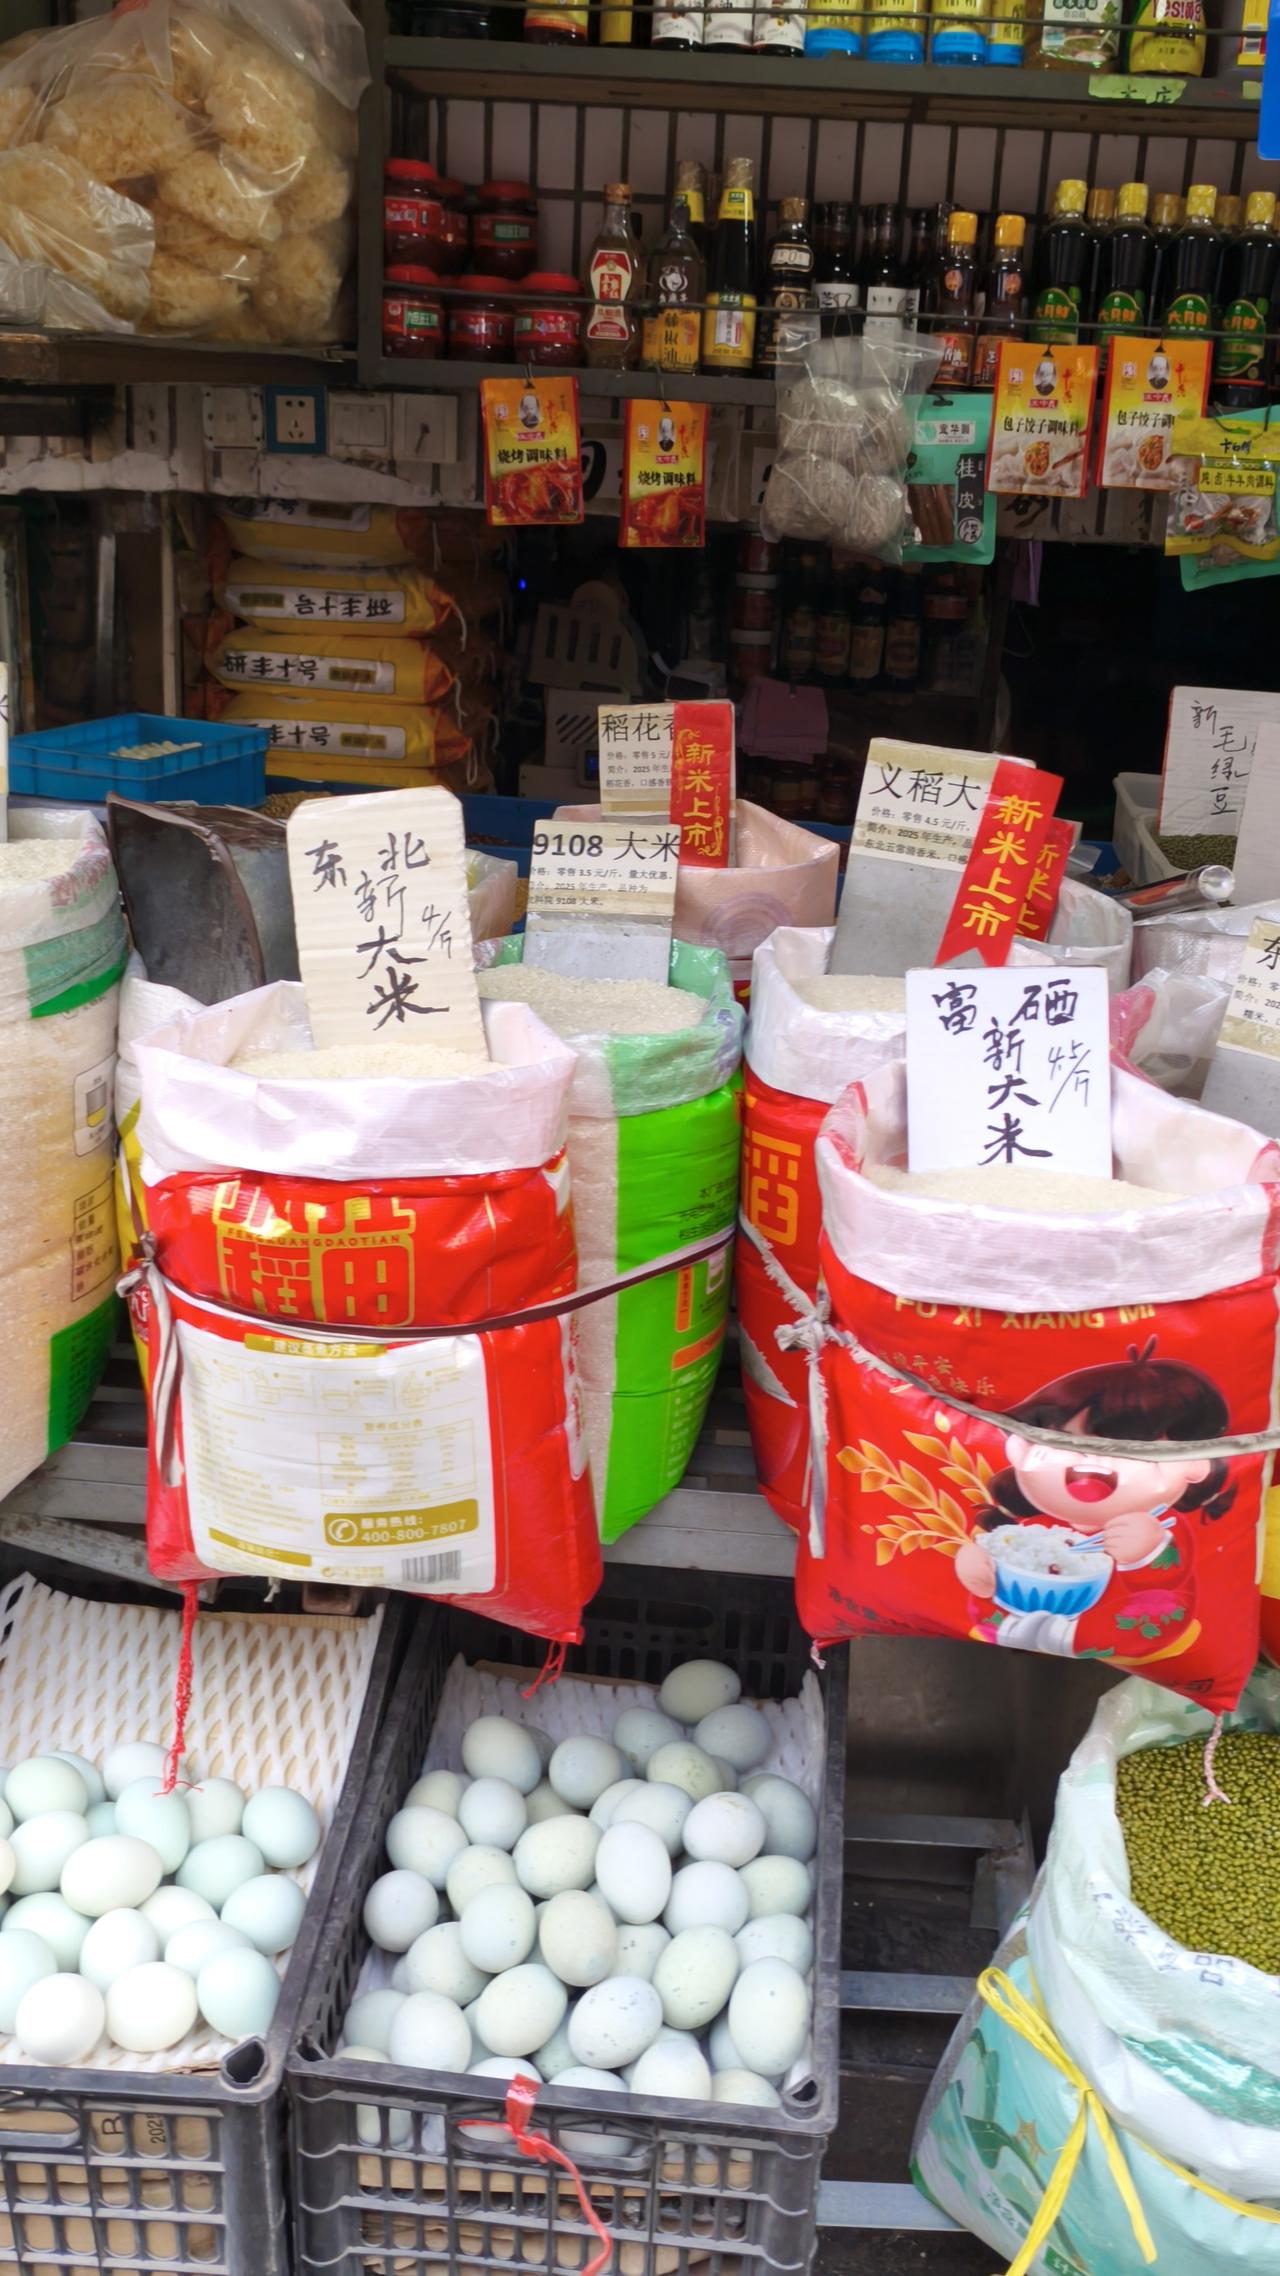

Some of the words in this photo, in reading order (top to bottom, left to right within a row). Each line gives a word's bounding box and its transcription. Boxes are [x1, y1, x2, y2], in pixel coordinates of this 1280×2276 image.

[682, 742, 717, 848] 新米上市
[868, 761, 988, 811] 义稻大
[304, 831, 432, 892] 东北
[532, 832, 604, 859] 9108
[613, 830, 681, 863] 大米
[961, 793, 1045, 938] 新米上市
[354, 869, 451, 1032] 新大米
[931, 978, 1079, 1036] 富硒
[977, 1015, 1054, 1166] 新大米
[360, 1518, 467, 1544] 400-800-7807
